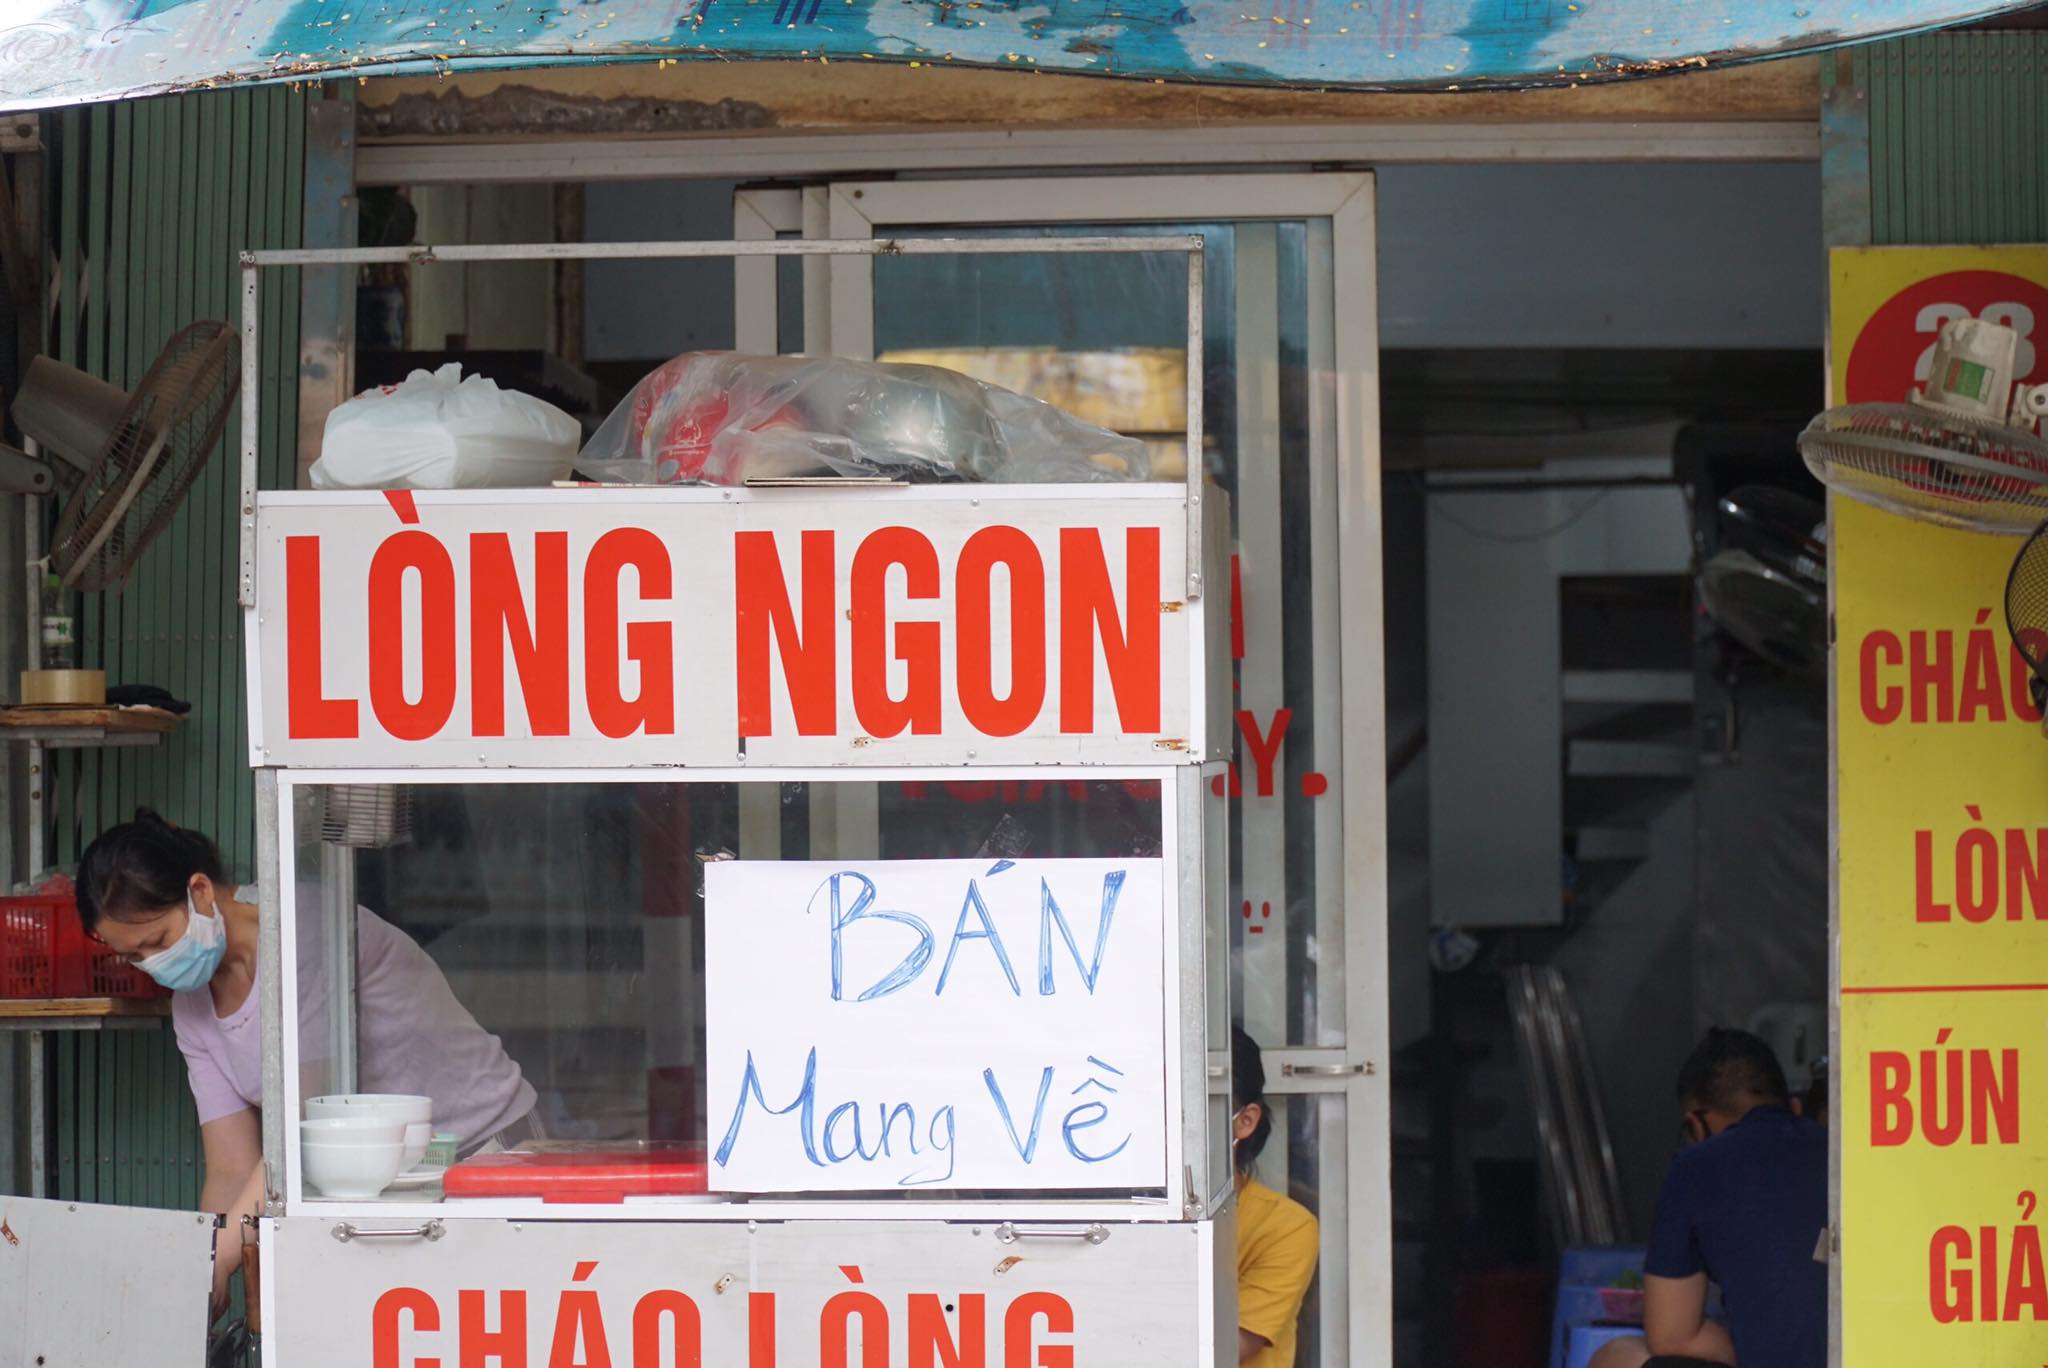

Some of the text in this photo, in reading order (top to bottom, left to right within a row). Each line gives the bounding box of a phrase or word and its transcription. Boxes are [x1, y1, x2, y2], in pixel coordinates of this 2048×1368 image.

[286, 490, 1161, 741] LÒNG NGON
[807, 860, 1126, 1001] BÁN
[714, 1046, 1132, 1185] Mang Về
[1870, 1028, 2019, 1146] BÚN
[373, 1261, 701, 1368] CHÁO
[1930, 1190, 2048, 1324] GIẢ
